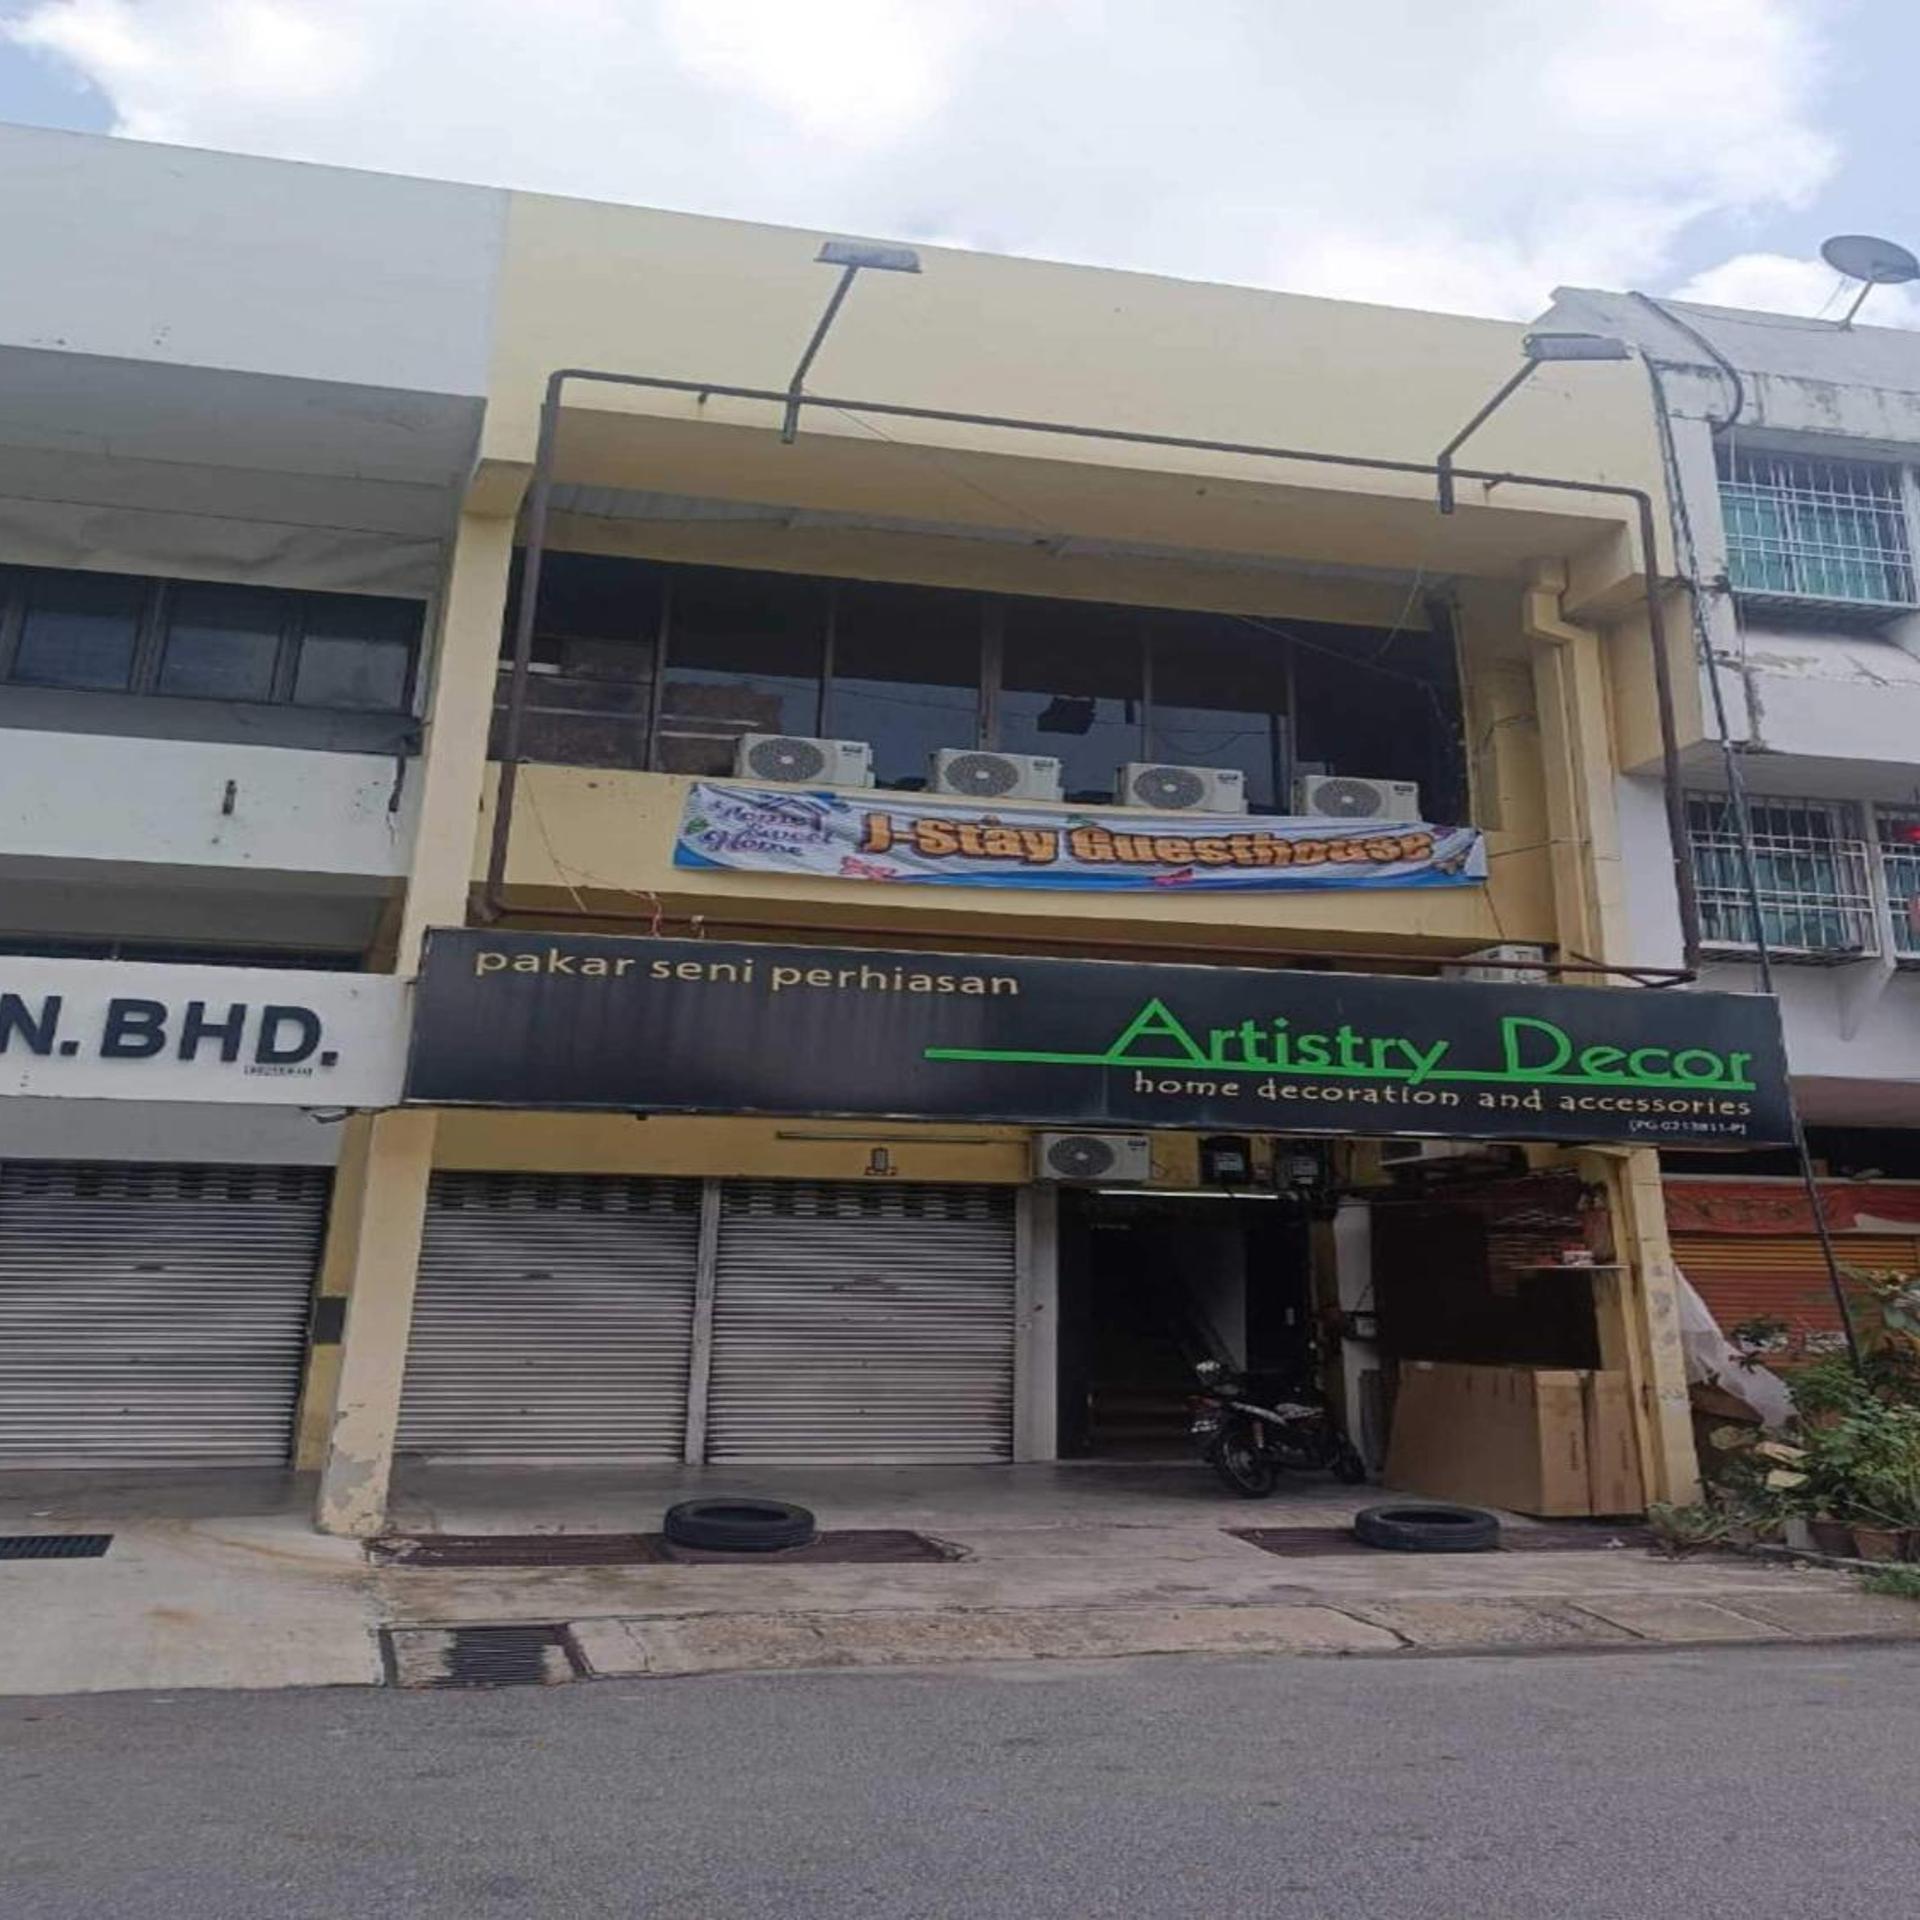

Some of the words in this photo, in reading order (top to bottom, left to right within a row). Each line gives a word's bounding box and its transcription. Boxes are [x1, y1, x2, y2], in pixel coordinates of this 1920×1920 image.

[860, 811, 1059, 866] J-Stay
[1068, 824, 1433, 866] Guesthouse
[476, 948, 635, 977] pakar
[648, 958, 754, 985] seni
[770, 964, 1019, 996] perhiasan
[100, 998, 339, 1067] BHD.
[1103, 997, 1449, 1086] Artistry
[1502, 1015, 1755, 1090] Decor
[1133, 1069, 1241, 1097] home
[1257, 1077, 1460, 1106] decoration
[1478, 1088, 1542, 1112] and
[1559, 1094, 1752, 1116] accessories
